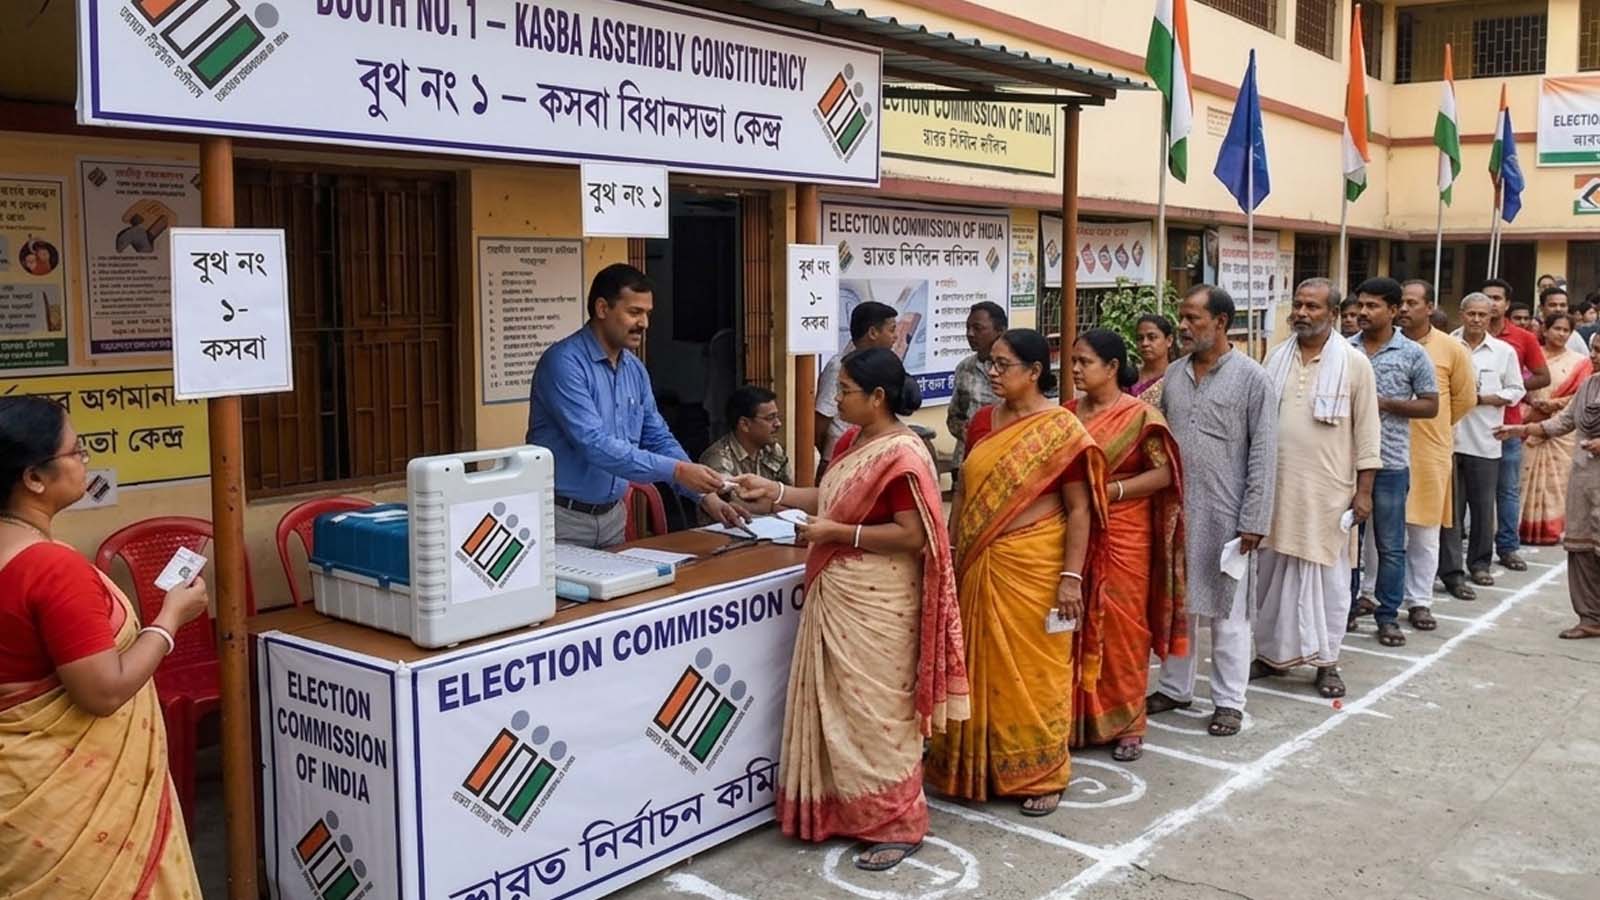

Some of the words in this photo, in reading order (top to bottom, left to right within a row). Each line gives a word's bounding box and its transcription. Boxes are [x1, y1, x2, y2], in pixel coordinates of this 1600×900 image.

[417, 0, 457, 36] NO.
[467, 0, 476, 39] 1
[515, 2, 583, 56] KASBA
[589, 17, 685, 72] ASSEMBLY
[691, 36, 807, 91] CONSTITUENCY
[355, 58, 410, 122] বুথ
[417, 66, 459, 116] নং
[471, 74, 488, 115] ১
[536, 82, 610, 131] কসবা
[617, 79, 726, 143] বিধানসভা
[1009, 107, 1022, 131] OF
[1553, 113, 1600, 127] ELECTIO
[587, 182, 617, 214] বুথ
[622, 184, 646, 208] নং
[652, 186, 662, 208] ১
[829, 212, 890, 235] ELECTION
[190, 250, 229, 285] বুথ
[236, 252, 267, 277] নং
[200, 334, 267, 361] কসবা
[128, 425, 185, 452] কেন্দ্র
[437, 637, 602, 713] ELECTION
[613, 588, 783, 662] COMMISSION
[791, 583, 805, 610] O
[287, 670, 371, 721] ELECTION
[277, 707, 387, 769] COMMISSION
[296, 753, 317, 784] OF
[322, 760, 371, 805] INDIA
[579, 799, 704, 871] নির্বাচন
[714, 757, 779, 809] কমি
